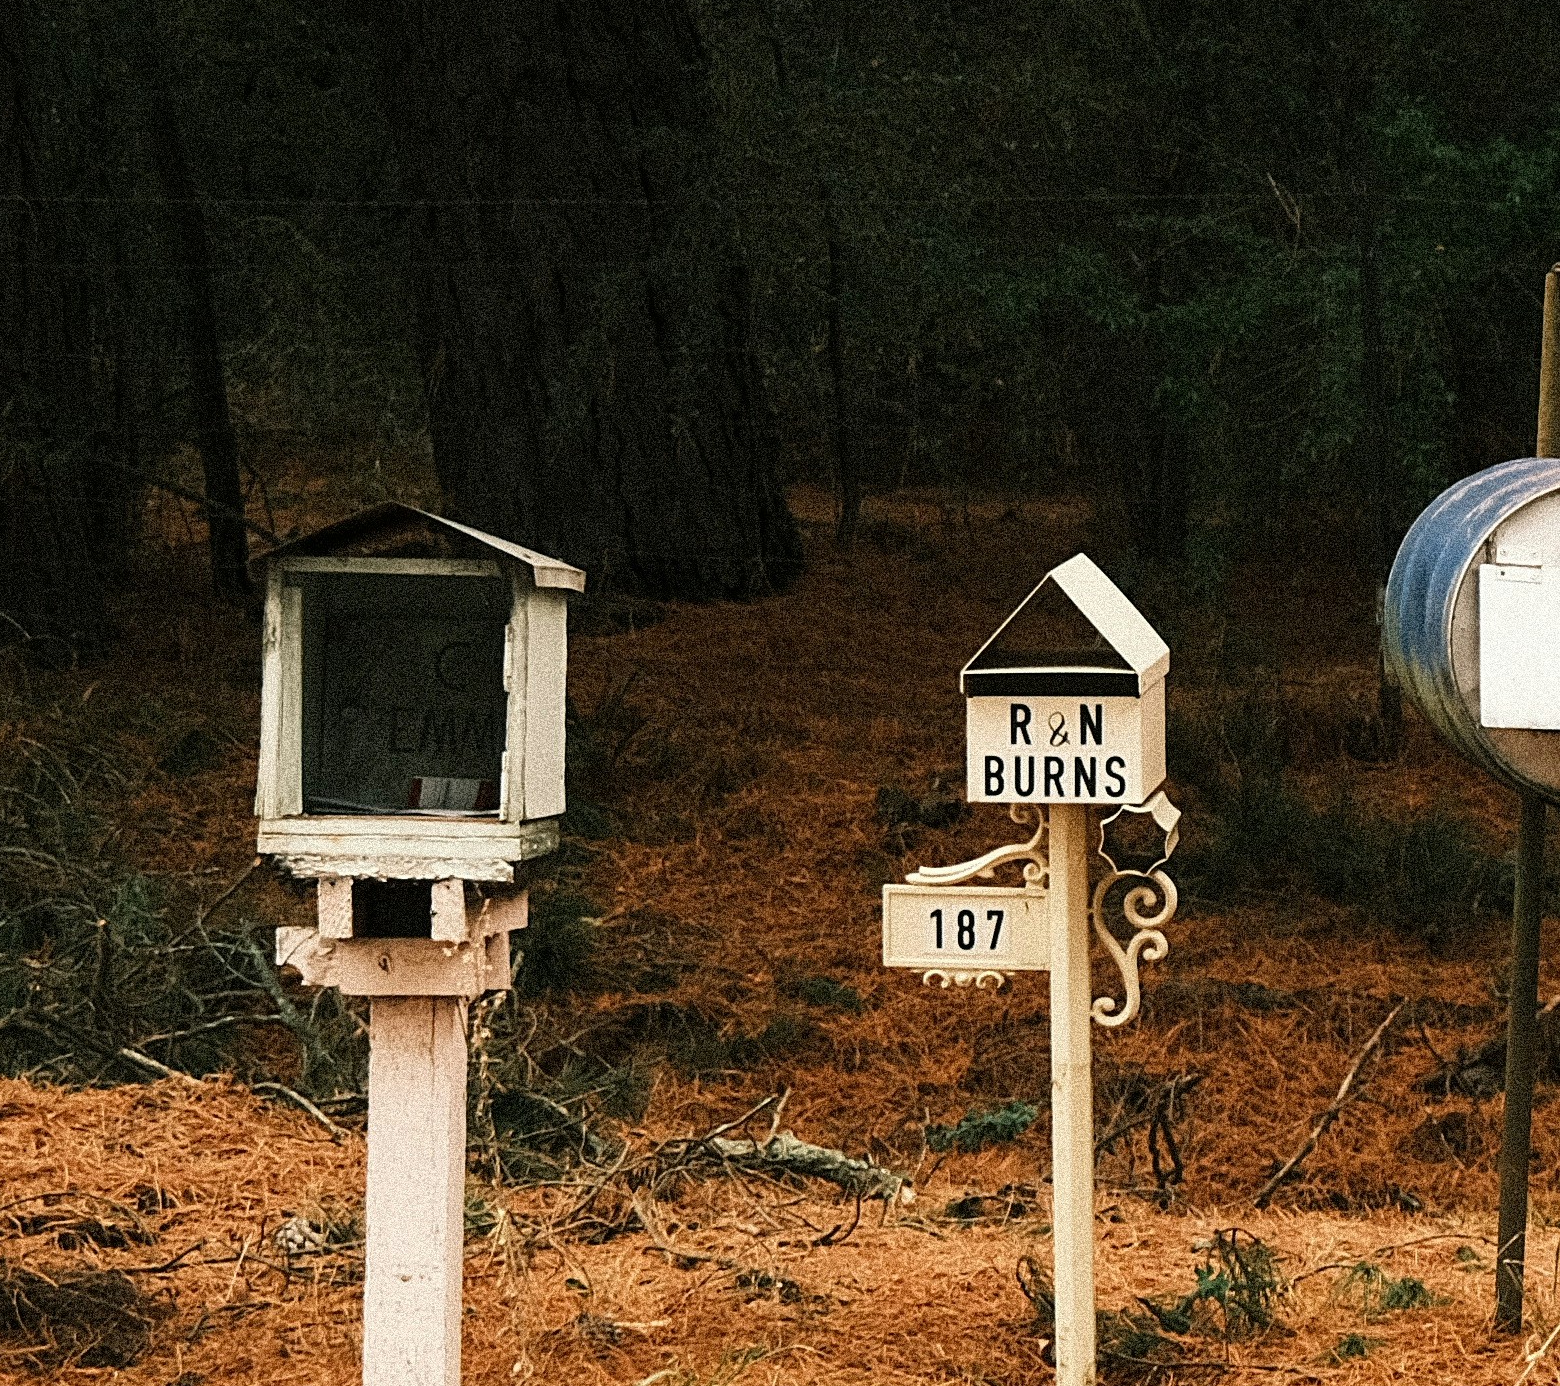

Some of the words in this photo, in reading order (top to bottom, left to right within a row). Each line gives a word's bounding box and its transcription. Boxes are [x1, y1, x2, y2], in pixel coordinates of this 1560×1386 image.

[1010, 703, 1032, 746] R
[1047, 710, 1071, 747] &
[1080, 703, 1103, 746] N
[984, 755, 1127, 797] BURNS
[929, 908, 1005, 951] 187
